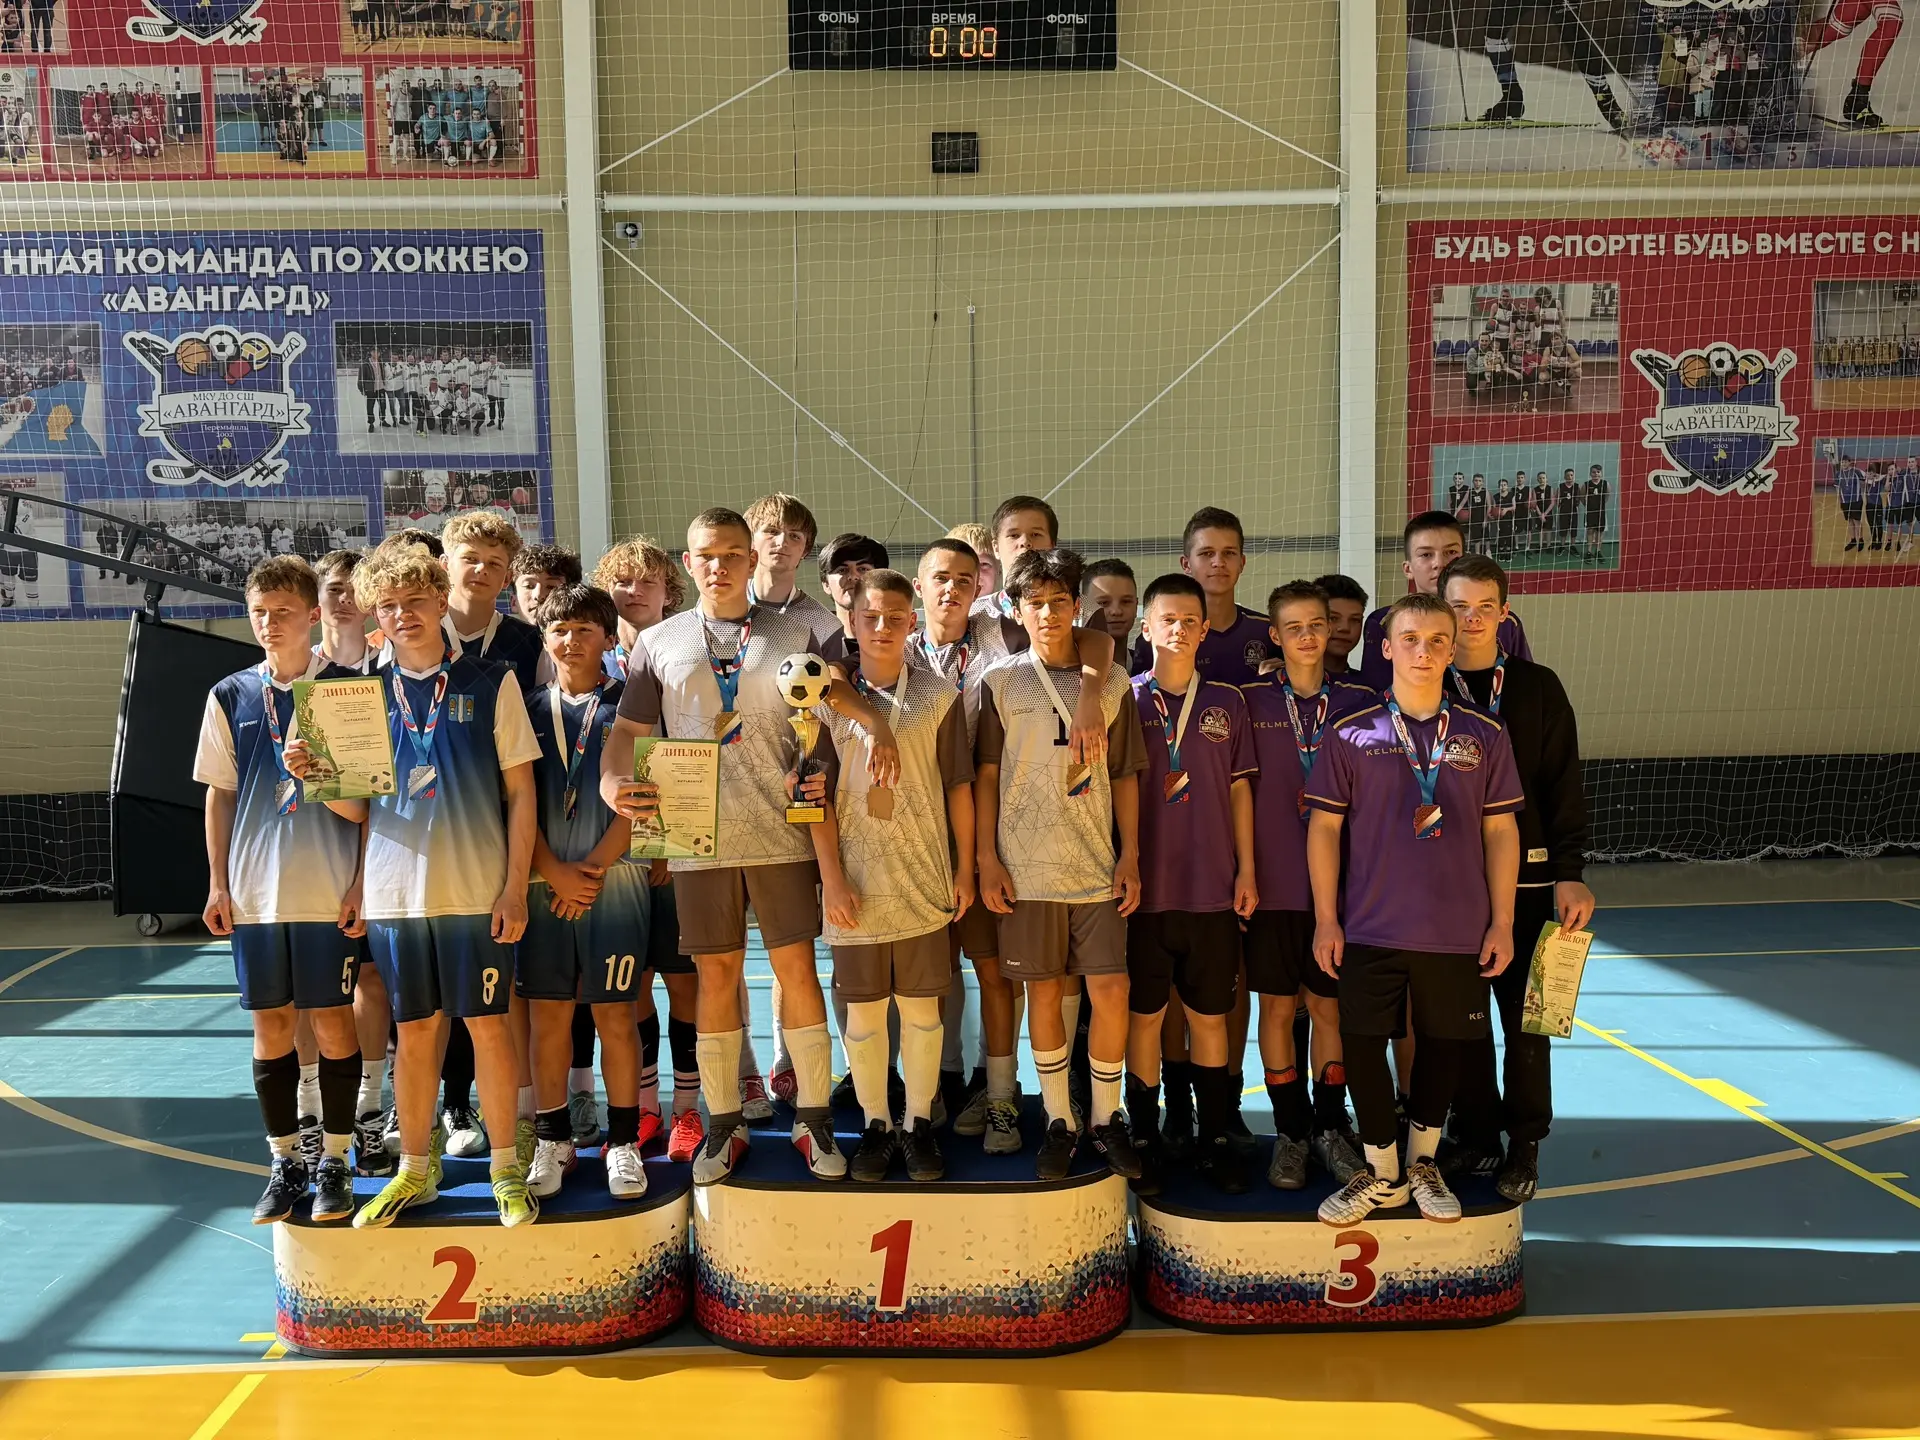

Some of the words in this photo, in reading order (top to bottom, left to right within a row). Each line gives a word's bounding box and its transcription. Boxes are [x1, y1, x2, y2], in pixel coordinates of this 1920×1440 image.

[818, 12, 859, 24] ФОЛЫ
[931, 13, 976, 24] ВРЕМЯ
[1046, 13, 1088, 25] ФОЛЫ
[1434, 236, 1511, 262] БУДЬ
[1517, 235, 1535, 257] В
[1542, 234, 1666, 258] СПОРТЕ!
[1674, 233, 1750, 259] БУДЬ
[1755, 232, 1866, 255] ВМЕСТЕ
[1873, 231, 1893, 254] С
[3, 247, 104, 275] ННАЯ
[115, 246, 302, 278] КОМАНДА
[310, 246, 363, 273] ПО
[371, 246, 529, 273] ХОККЕЮ
[102, 285, 331, 316] «АВАНГАРД»
[193, 392, 216, 402] МКУ
[218, 391, 234, 402] ДО
[237, 392, 255, 401] СШ
[163, 401, 286, 421] «АВАНГАРД»
[1693, 406, 1715, 415] МКУ
[1716, 405, 1731, 415] ДО
[1733, 405, 1749, 414] СШ
[1665, 414, 1776, 433] «АВАНГАРД»
[322, 685, 376, 699] ДИПЛОМ
[1253, 721, 1289, 729] KELME
[661, 747, 712, 758] ДИПЛОМ
[1365, 746, 1405, 757] KELME
[341, 956, 354, 995] 5
[604, 954, 635, 992] 10
[482, 967, 499, 1006] 8
[870, 1219, 913, 1307] 1
[1327, 1229, 1380, 1304] 3
[424, 1245, 479, 1321] 2
